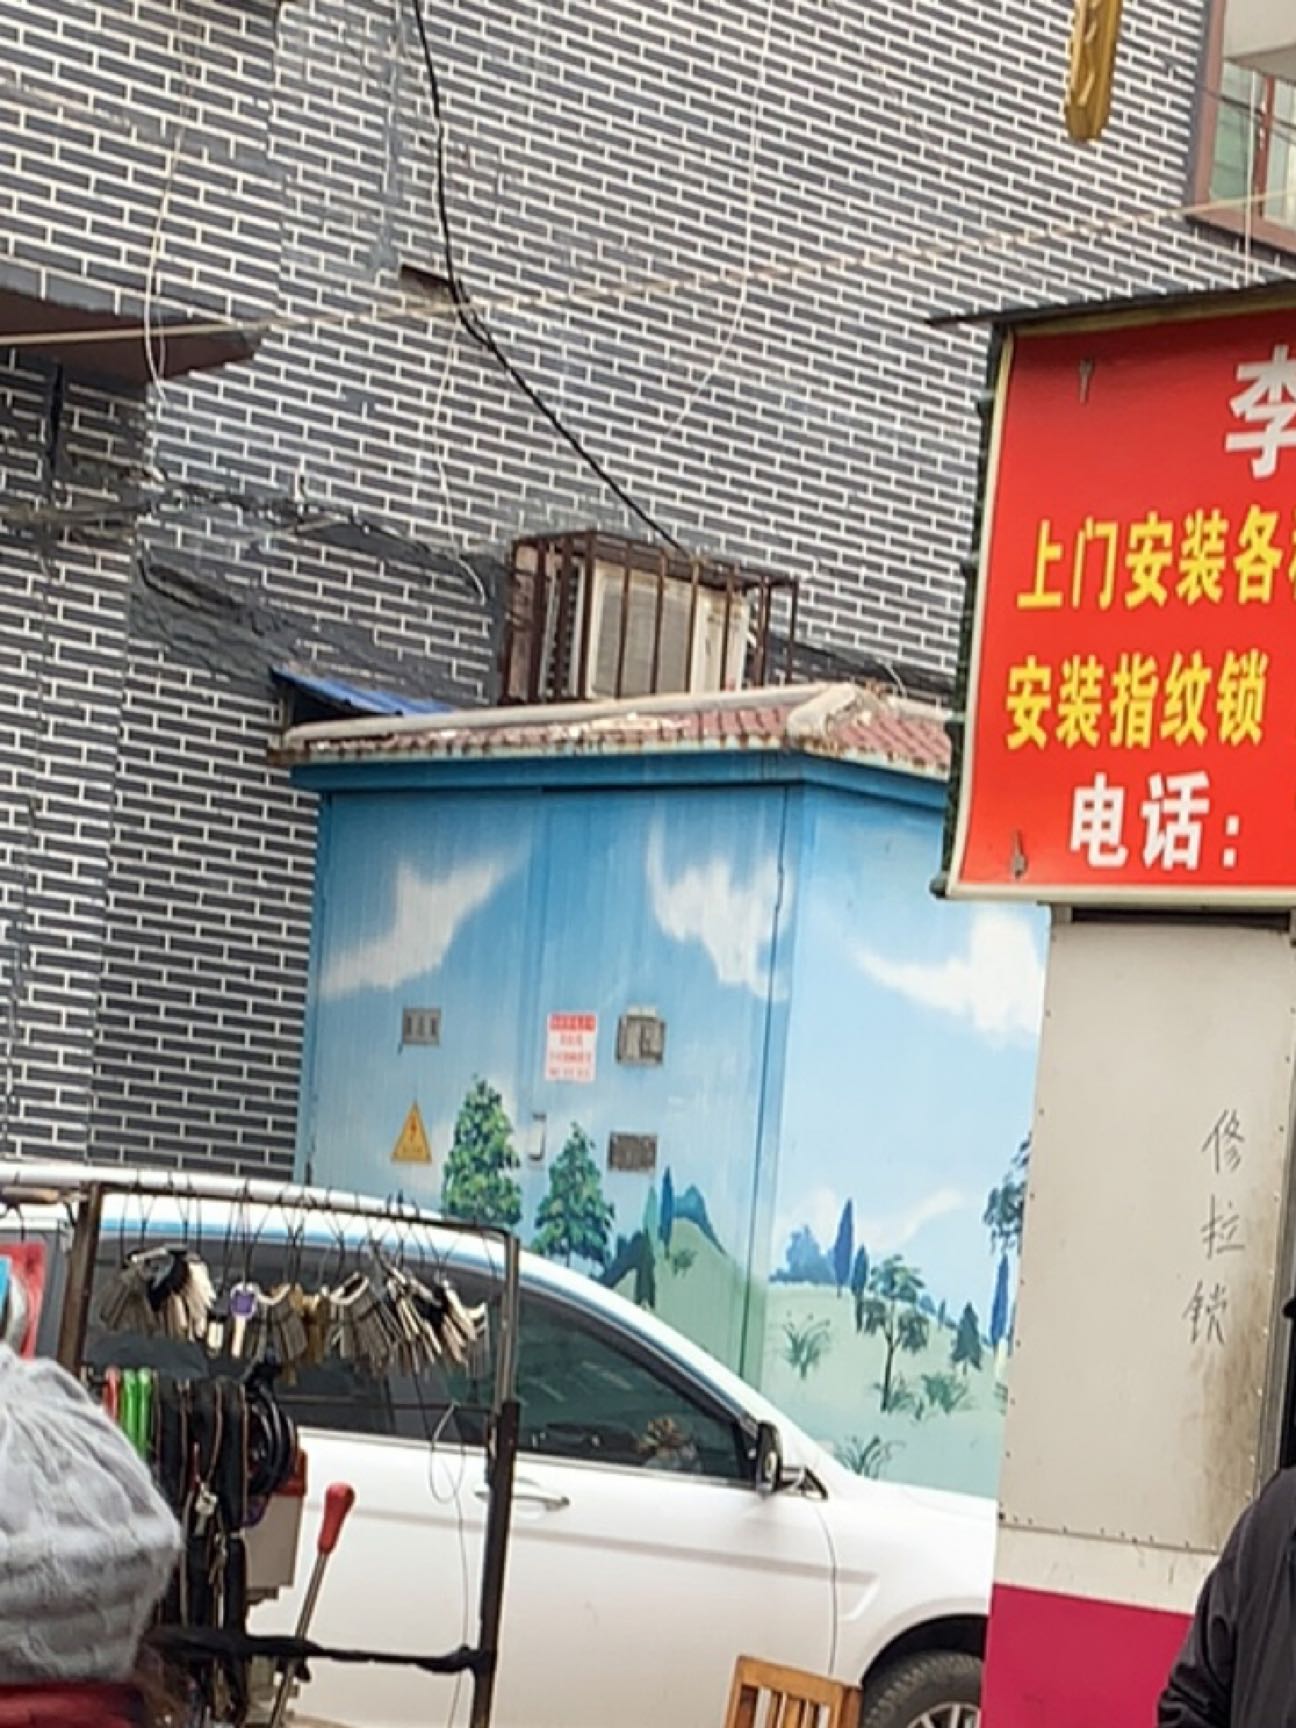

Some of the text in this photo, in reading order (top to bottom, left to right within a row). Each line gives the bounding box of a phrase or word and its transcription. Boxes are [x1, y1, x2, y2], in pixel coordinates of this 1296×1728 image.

[1006, 648, 1268, 750] 安装指纹锁
